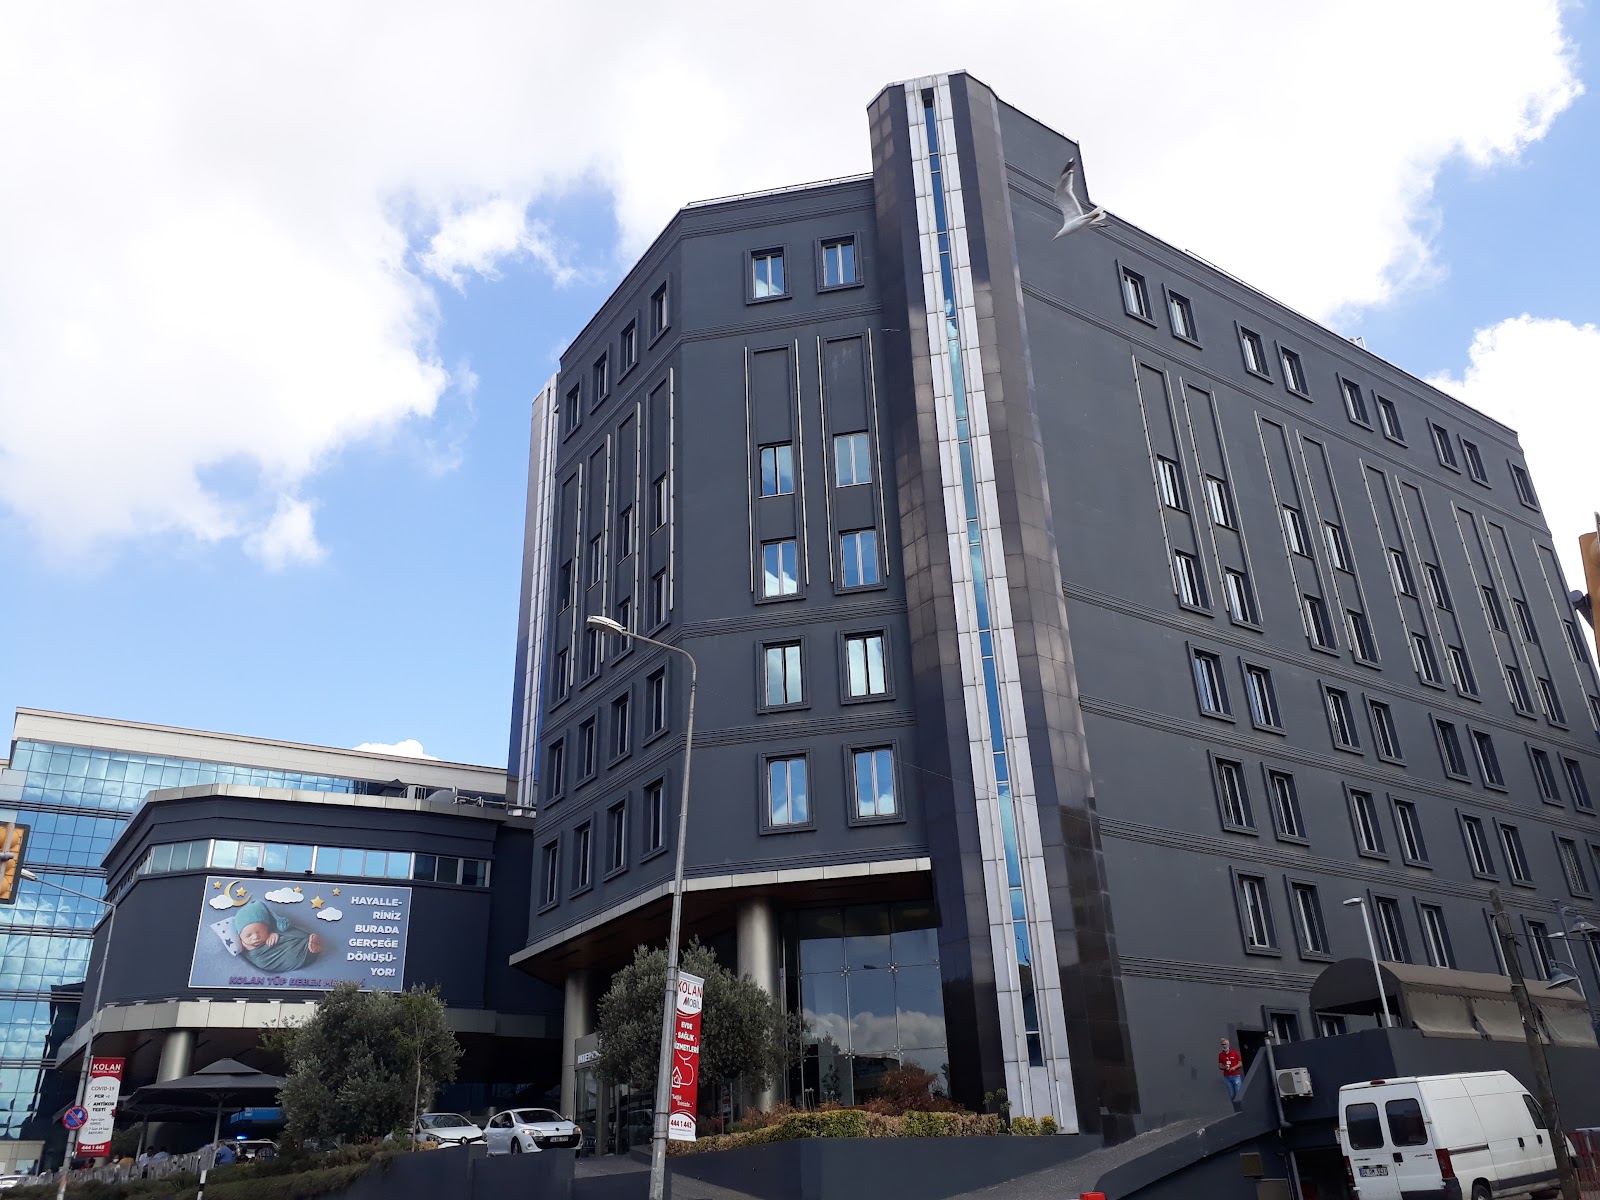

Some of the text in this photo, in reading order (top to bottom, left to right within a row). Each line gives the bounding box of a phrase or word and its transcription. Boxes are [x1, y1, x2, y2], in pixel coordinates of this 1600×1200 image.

[351, 896, 402, 906] HAYALLE-
[373, 909, 401, 920] RİNİZ
[355, 924, 399, 934] BURADA
[349, 938, 398, 949] GERÇEĞE
[347, 951, 397, 963] DÖNÜŞÜ-
[370, 967, 395, 976] YOR!
